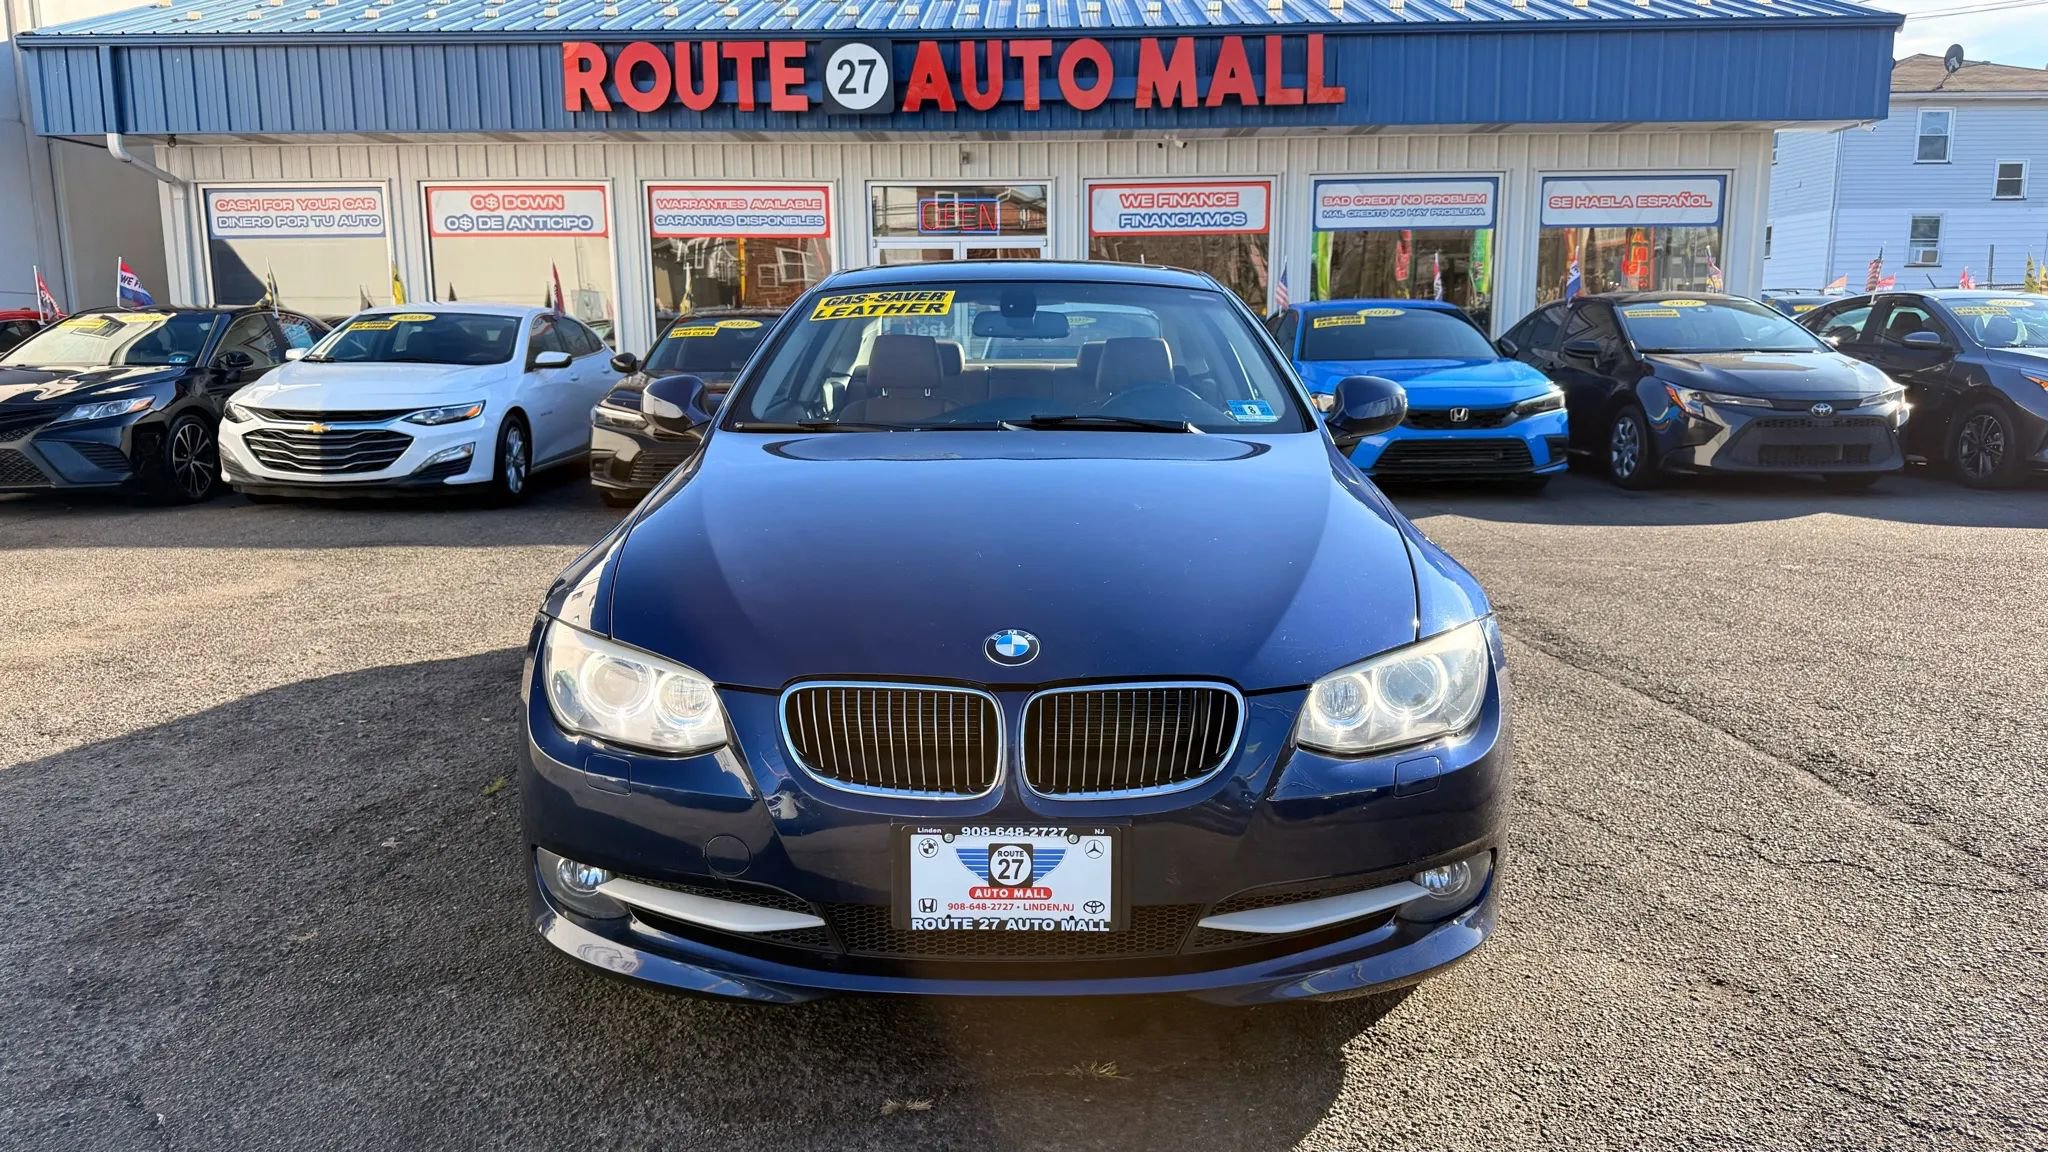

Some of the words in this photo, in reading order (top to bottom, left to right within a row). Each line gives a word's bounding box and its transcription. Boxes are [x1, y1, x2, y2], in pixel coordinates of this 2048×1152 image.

[563, 41, 809, 112] ROUTE
[837, 58, 877, 95] 27
[902, 38, 1114, 112] AUTO
[1135, 33, 1345, 109] MALL
[215, 198, 261, 211] CASH
[262, 198, 294, 211] FOR
[298, 197, 340, 211] YOUR
[342, 197, 376, 210] CAR
[502, 194, 564, 210] DOWN
[656, 198, 747, 211] WARRANTIES
[749, 198, 823, 210] AVAILABLE
[1119, 193, 1155, 208] WE
[1156, 192, 1239, 208] FINANCE
[1322, 195, 1351, 207] BAD
[1353, 194, 1399, 206] CREDIT
[1401, 194, 1422, 206] NO
[1423, 193, 1487, 205] PROBLEM
[1549, 196, 1573, 209] SE
[1575, 195, 1634, 208] HABLA
[1636, 192, 1713, 208] ESPAÑOL
[922, 202, 998, 230] OPEN
[1119, 212, 1248, 228] FINANCIAMOS
[1322, 209, 1345, 218] MAL
[1346, 208, 1388, 218] CREDITO
[1390, 208, 1405, 217] NO
[1407, 208, 1429, 217] HAY
[1430, 207, 1486, 217] PROBLEMA
[217, 215, 273, 229] DINERO
[275, 215, 308, 228] POR
[310, 215, 335, 227] TU
[337, 214, 381, 227] AUTO
[476, 215, 504, 231] DE
[506, 215, 594, 231] ANTICIPO
[655, 214, 735, 227] GARANTIAS
[735, 214, 826, 227] DISPONIBLES
[823, 291, 948, 307] GAS-SAVER
[812, 303, 946, 320] LEATHER
[1247, 406, 1256, 414] 8
[961, 827, 1068, 837] 908-648-2727
[997, 850, 1024, 858] ROUTE
[997, 859, 1024, 880] 27
[974, 888, 1009, 898] AUTO
[1013, 888, 1048, 898] MALL
[947, 902, 1014, 911] 908-648-2727
[1023, 903, 1075, 912] LINDEN,NJ
[911, 917, 975, 931] ROUTE
[978, 917, 1001, 931] 27
[1004, 918, 1055, 931] AUTO
[1061, 918, 1110, 932] MALL
